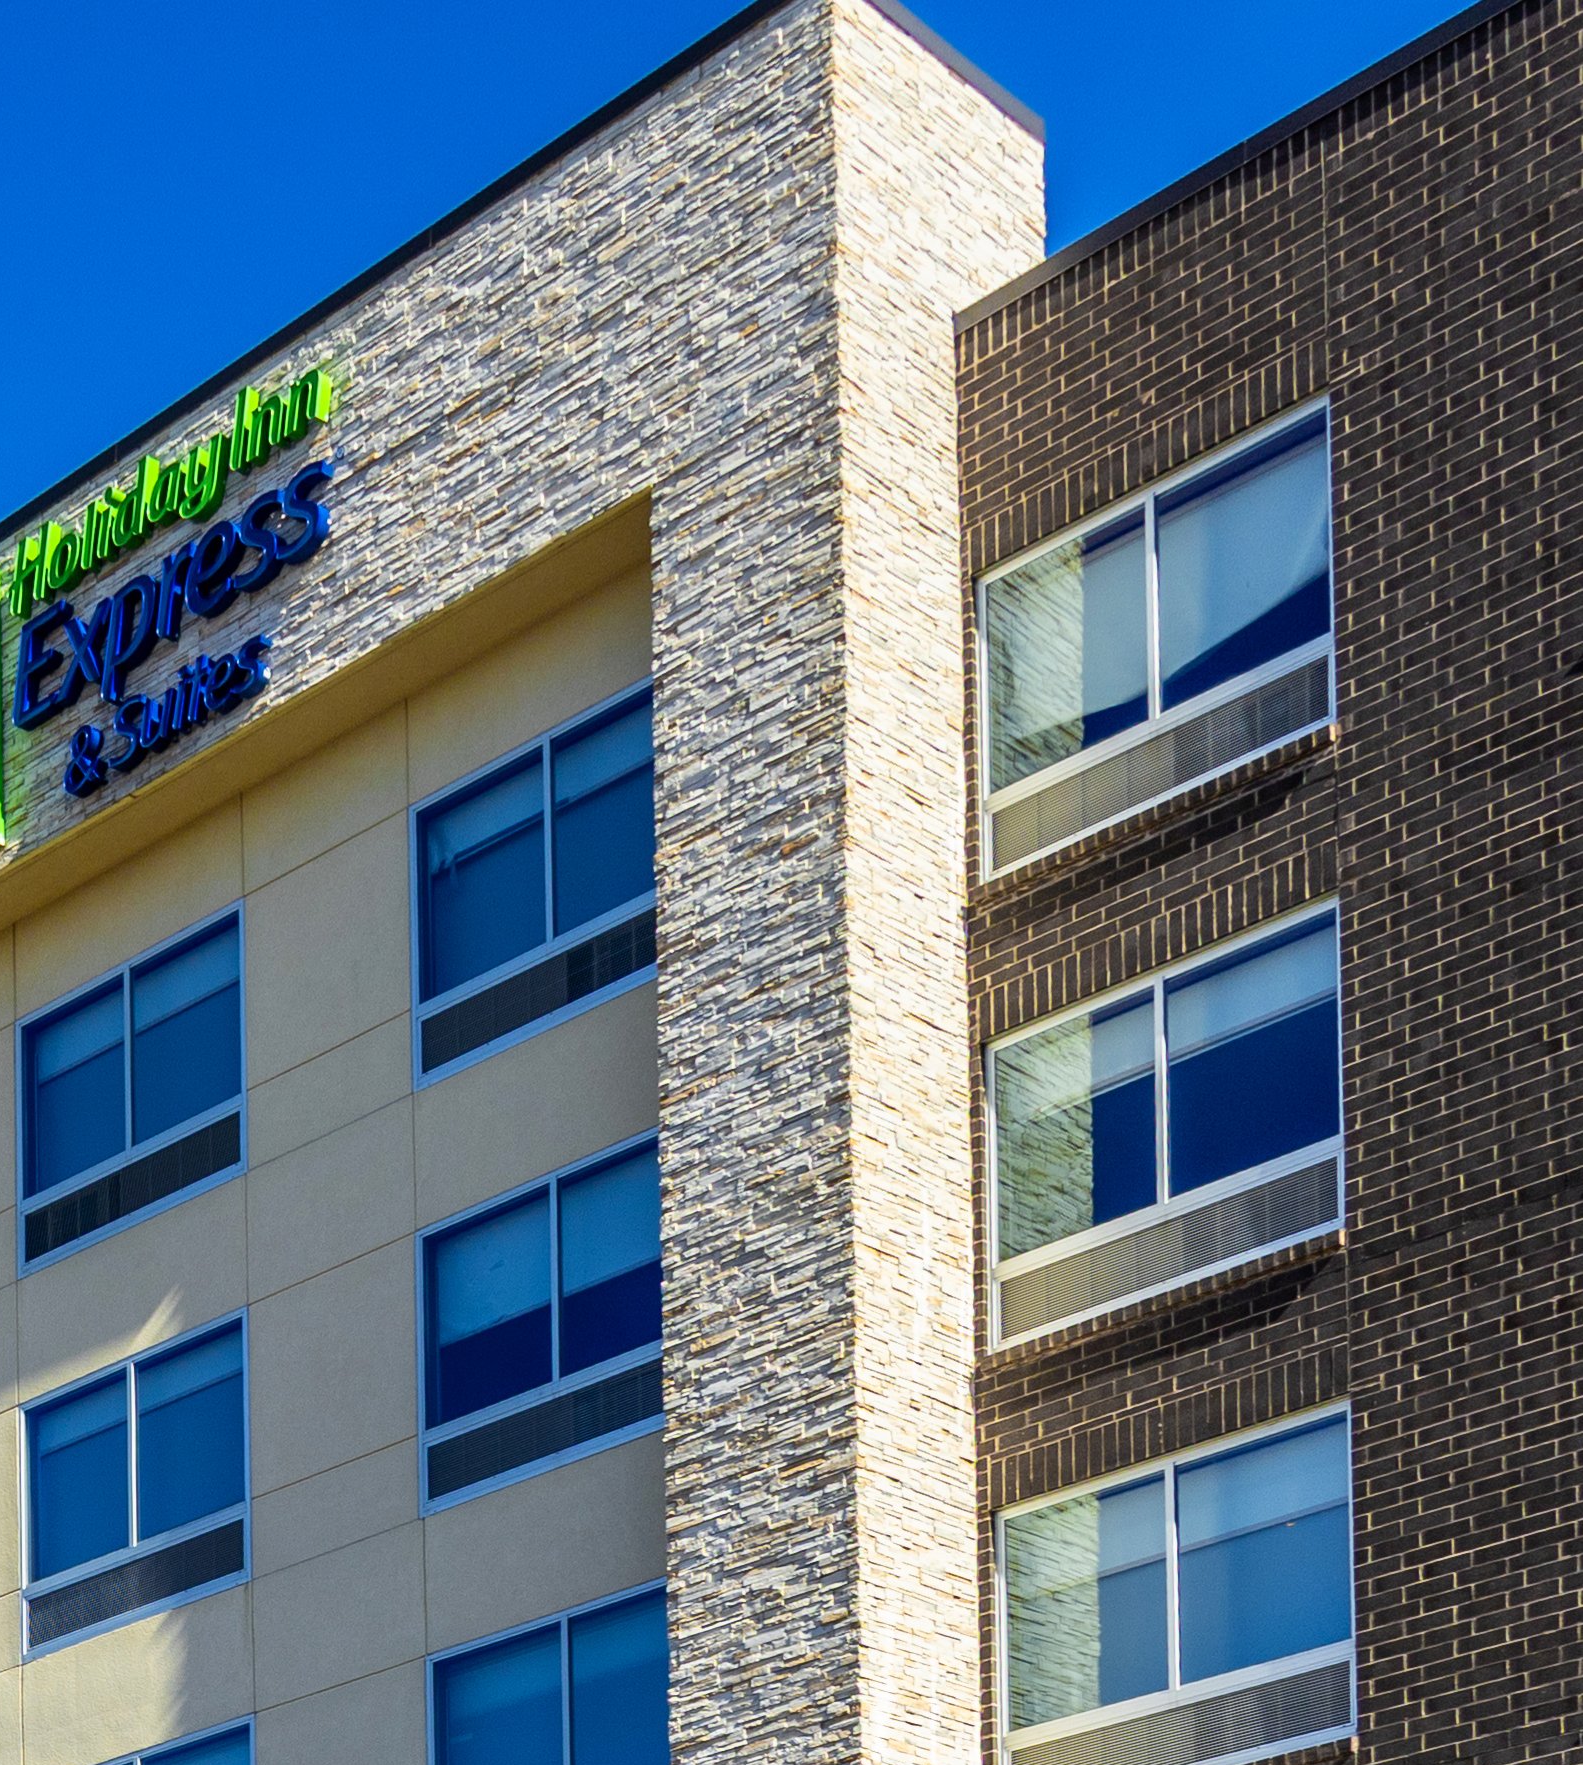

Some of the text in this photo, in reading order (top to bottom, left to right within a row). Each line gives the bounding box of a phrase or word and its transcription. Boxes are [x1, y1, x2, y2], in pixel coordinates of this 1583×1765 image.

[8, 369, 332, 618] Holiday Inn
[11, 459, 333, 731] Express
[62, 633, 272, 797] & Suites
